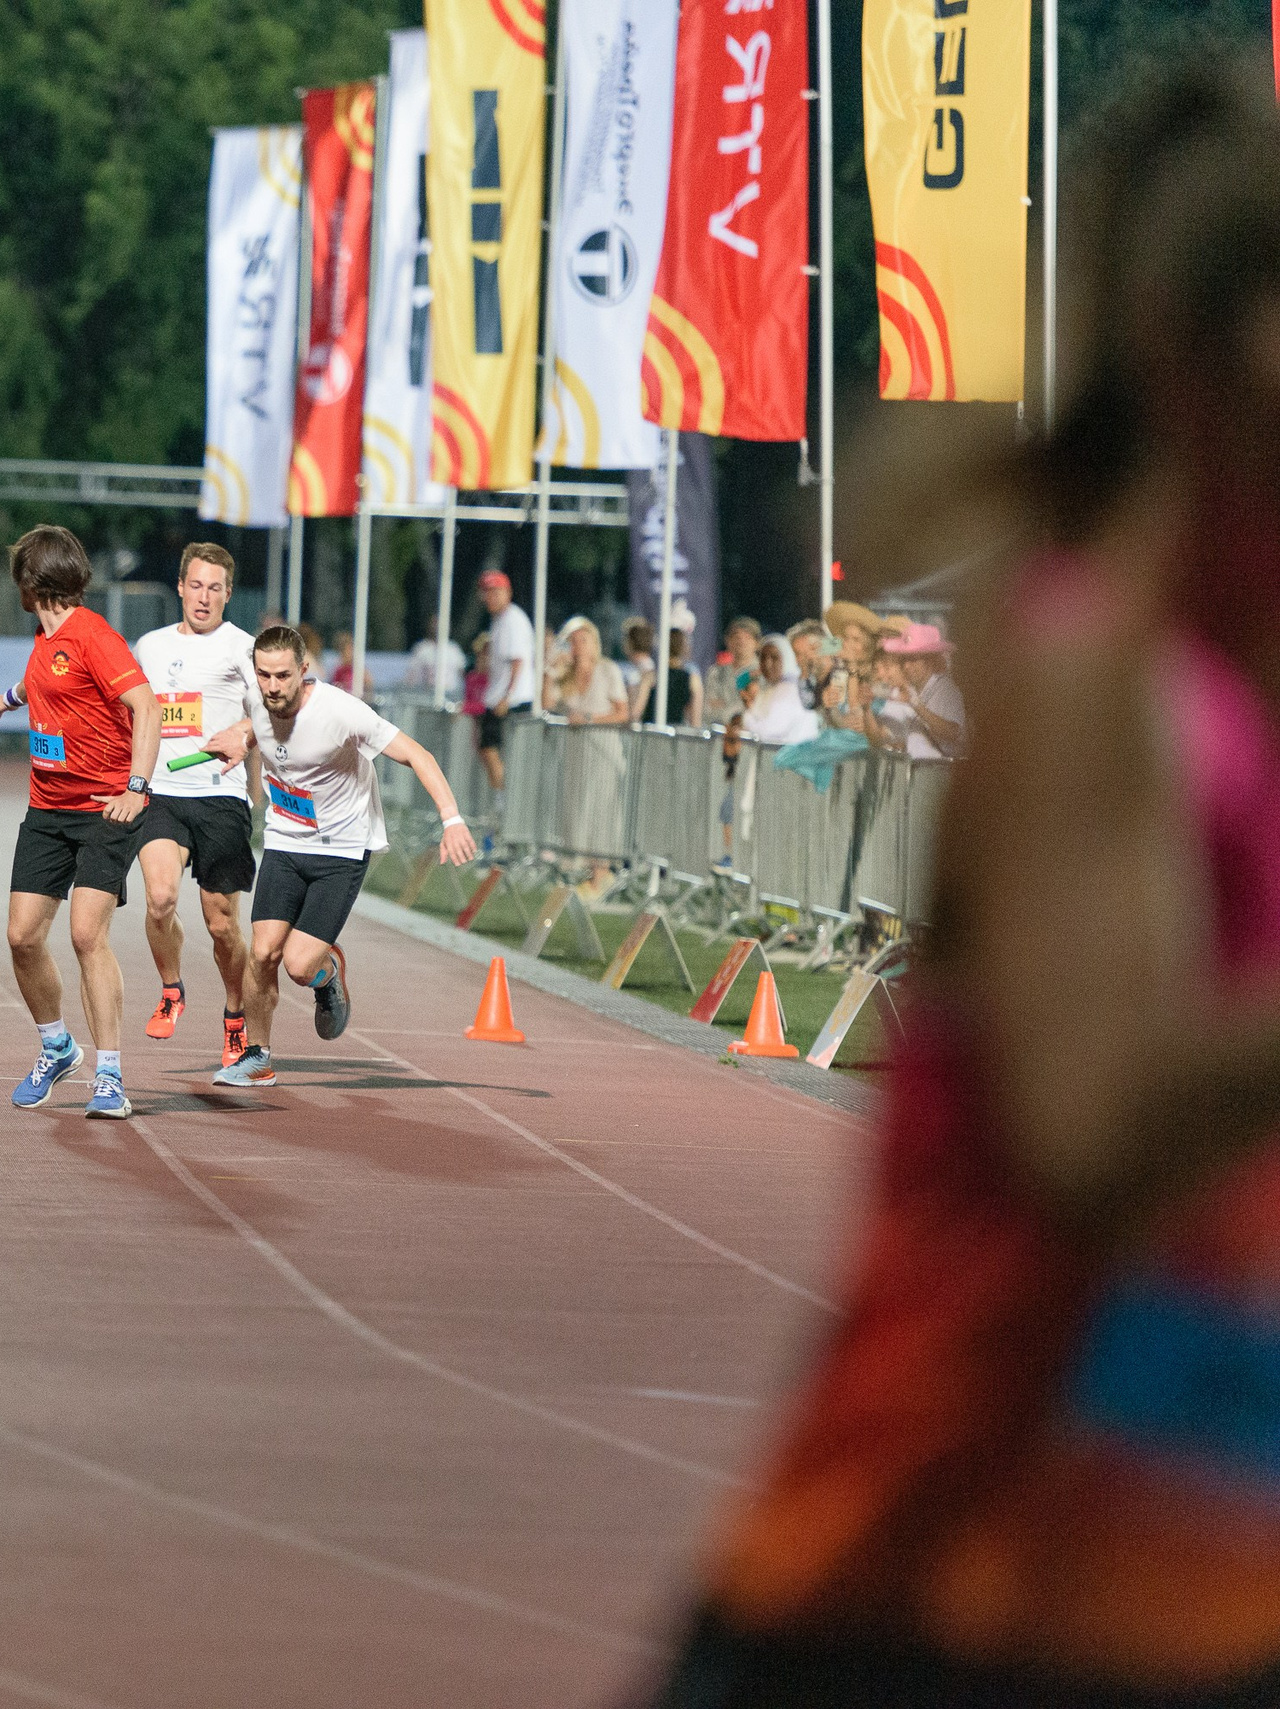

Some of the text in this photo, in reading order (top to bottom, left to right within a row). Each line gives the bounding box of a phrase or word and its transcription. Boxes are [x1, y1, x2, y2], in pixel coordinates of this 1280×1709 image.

[923, 0, 969, 190] GE
[162, 707, 196, 722] 314 2
[34, 737, 59, 756] 315 3
[281, 794, 300, 812] 314
